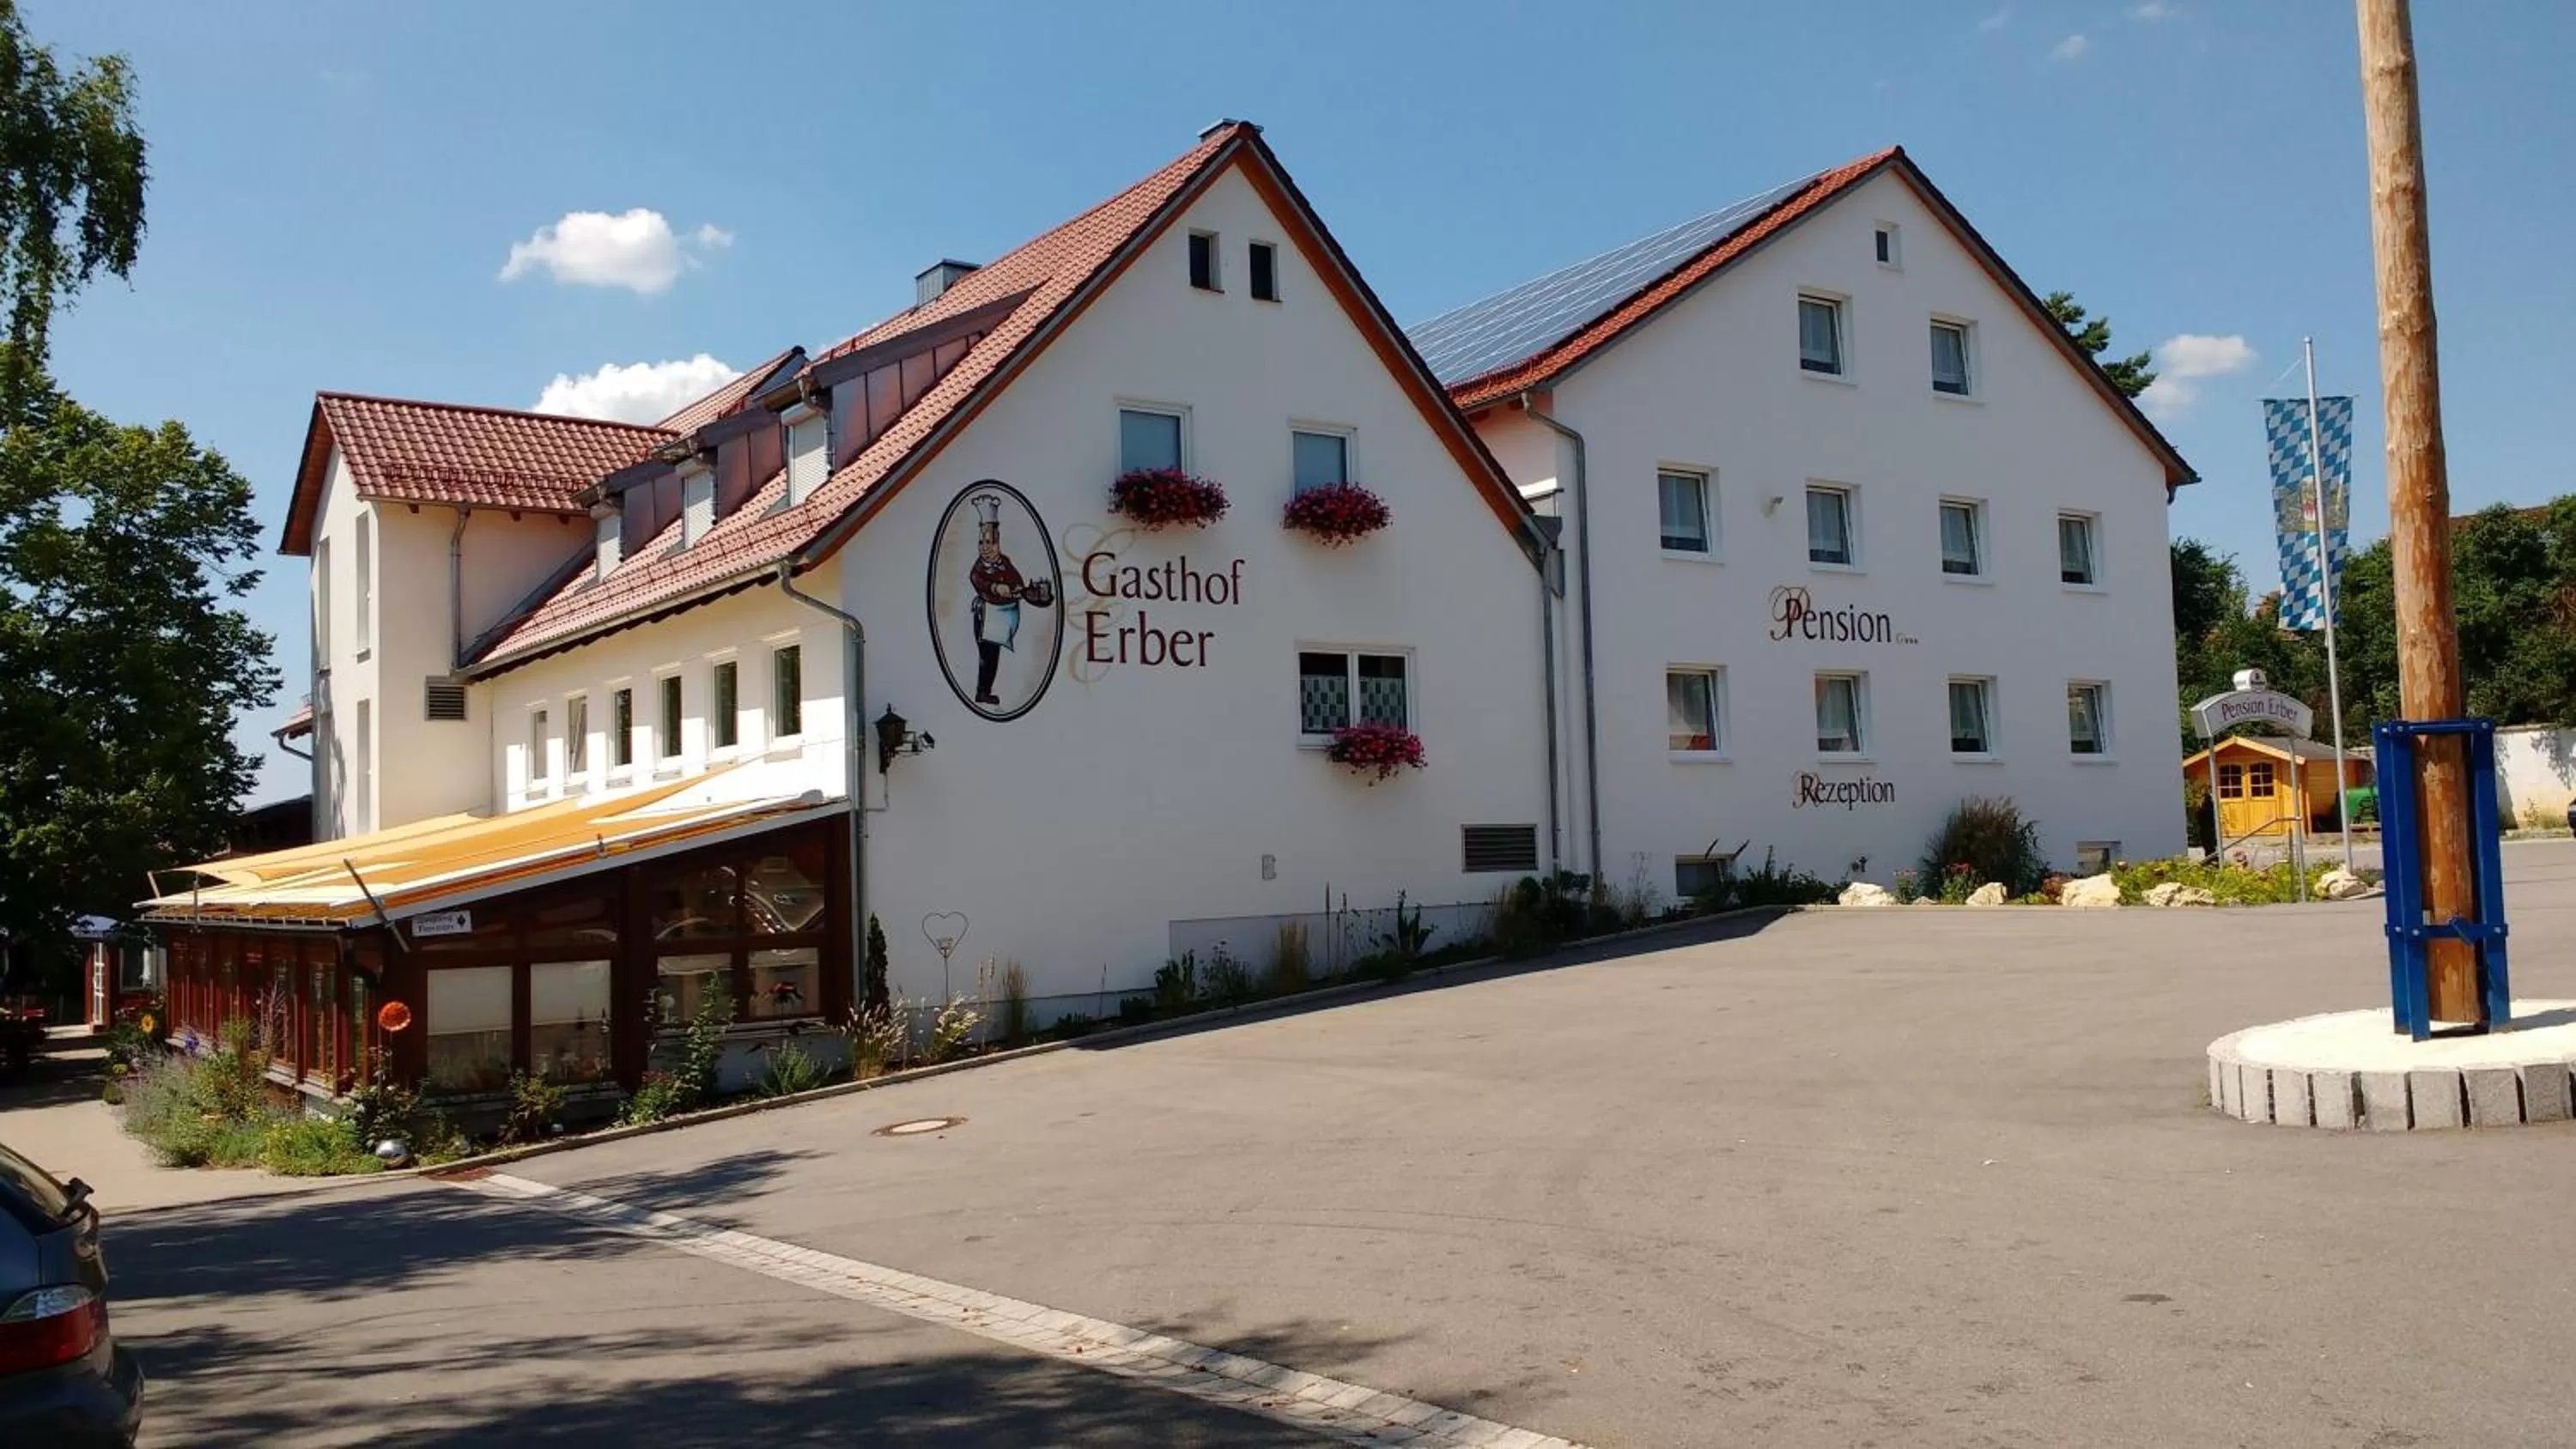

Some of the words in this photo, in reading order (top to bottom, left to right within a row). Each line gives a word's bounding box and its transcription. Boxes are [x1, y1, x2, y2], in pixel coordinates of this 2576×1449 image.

[1082, 551, 1246, 605] Gasthof
[1085, 610, 1215, 667] Erber
[1771, 585, 1892, 643] Pension
[2221, 700, 2264, 721] Pension
[2269, 696, 2298, 721] Erber
[1793, 772, 1895, 810] Rezeption
